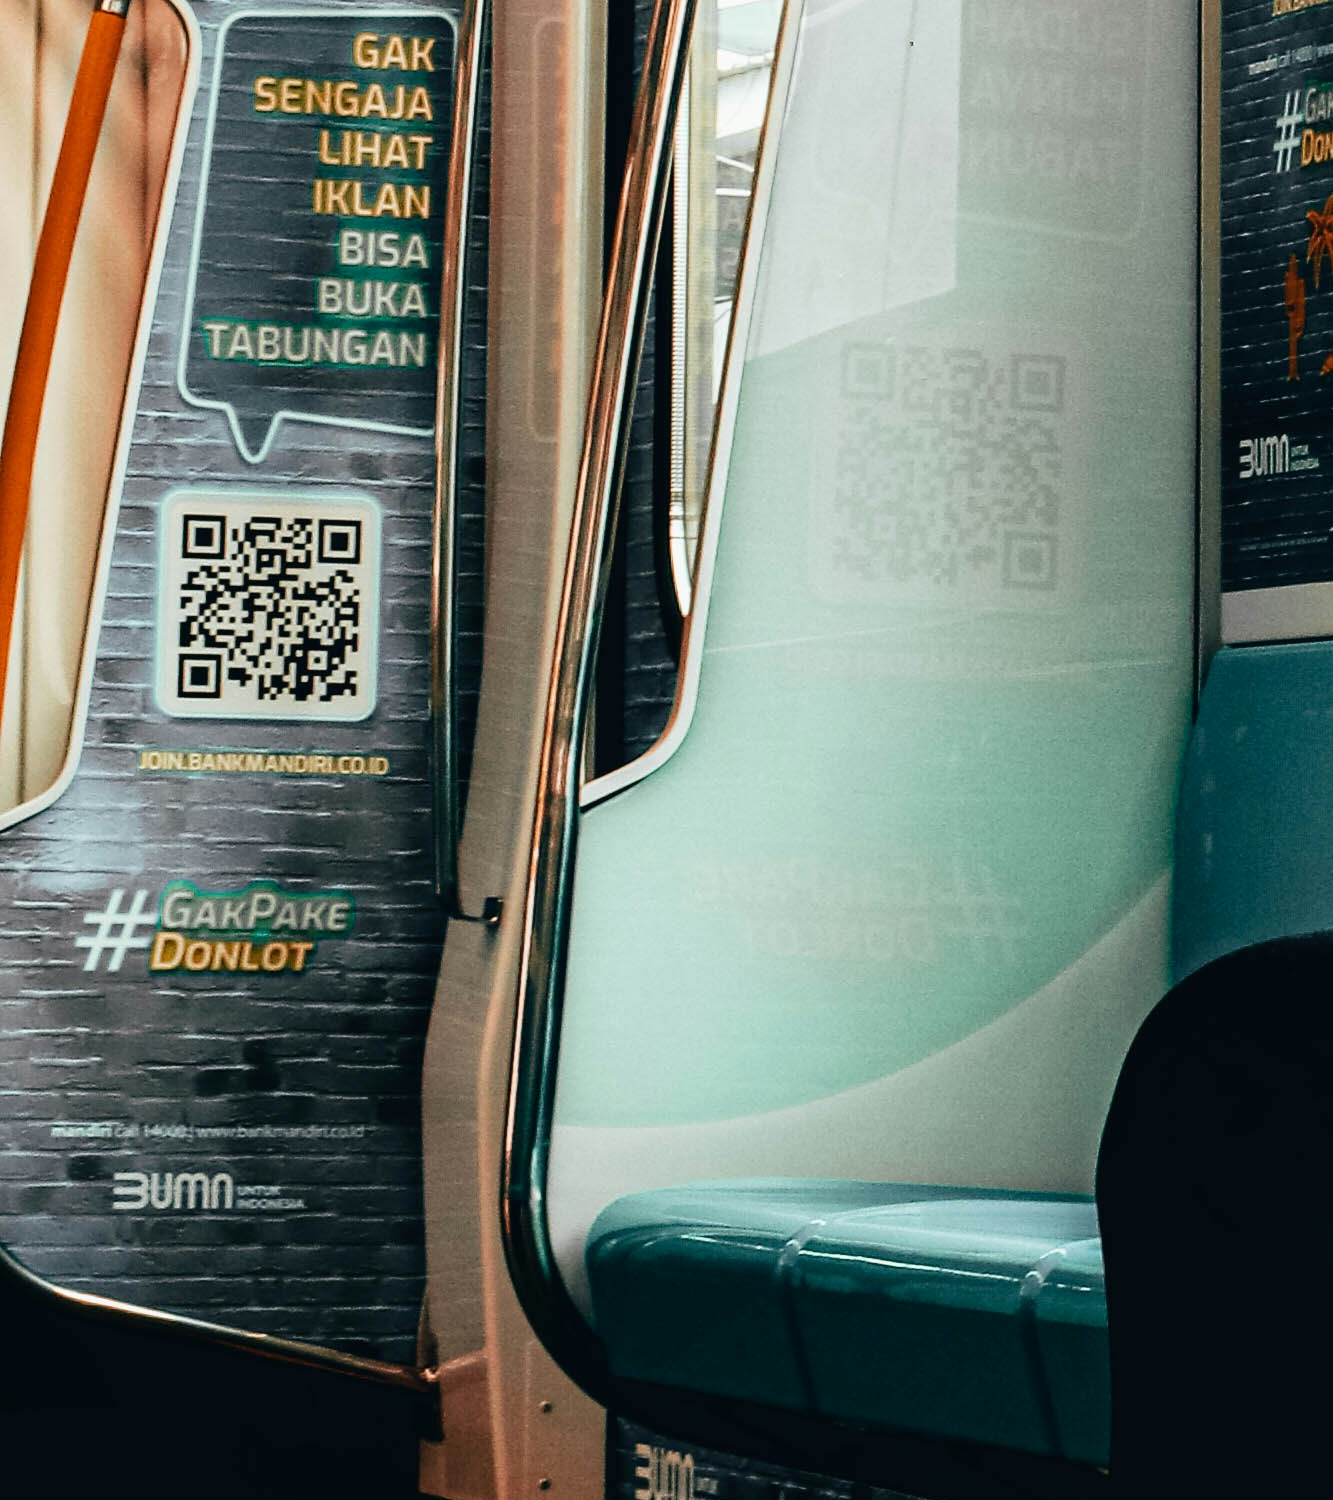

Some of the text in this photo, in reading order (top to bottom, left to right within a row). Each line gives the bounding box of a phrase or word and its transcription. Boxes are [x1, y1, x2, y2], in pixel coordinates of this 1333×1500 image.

[353, 30, 437, 74] GAK
[253, 76, 434, 123] SENGAJA
[318, 129, 434, 171] LIHAT
[312, 177, 432, 220] IKLAN
[338, 229, 430, 270] BISA
[316, 277, 428, 319] BUKA
[204, 321, 427, 369] TABUNGAN
[1239, 433, 1290, 479] BUMN
[138, 750, 390, 777] JOIN.BANKMANDIRI.CO.ID
[150, 930, 316, 973] DONLOT
[51, 1124, 113, 1139] mandiri
[112, 1172, 234, 1211] BUMN
